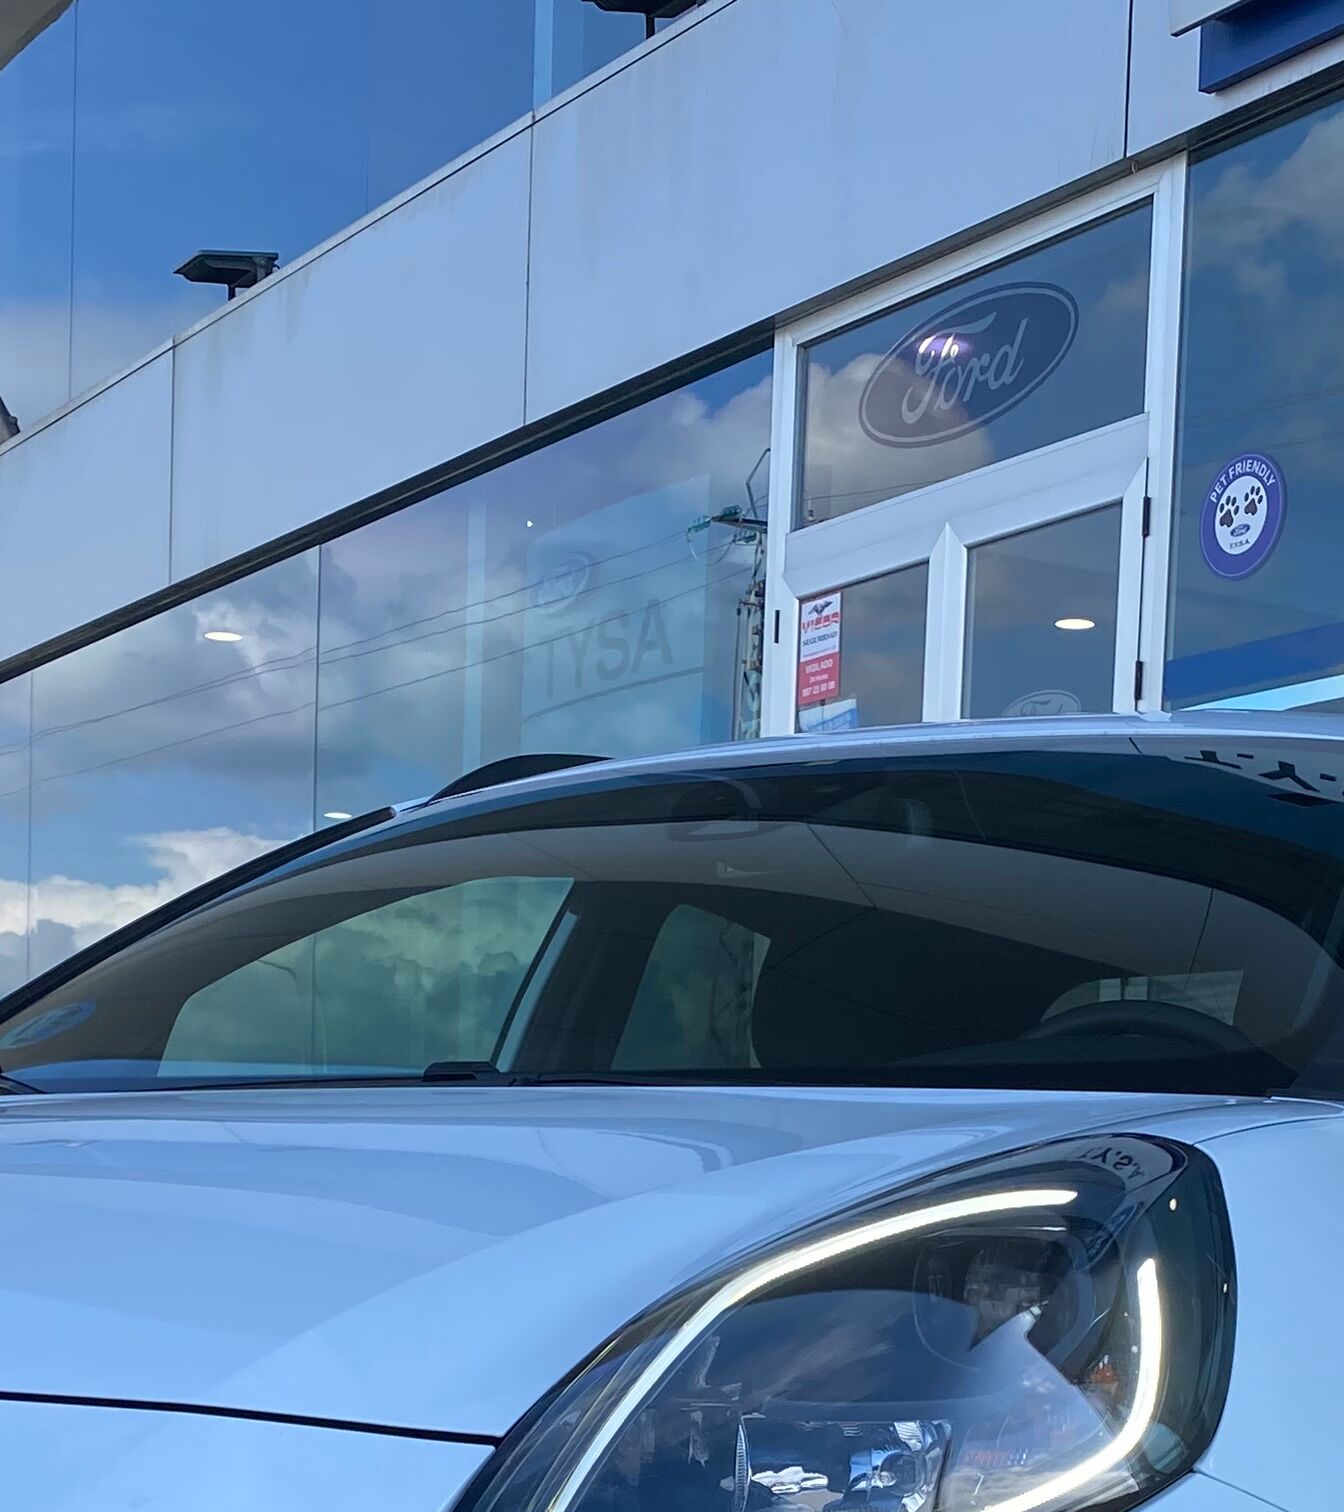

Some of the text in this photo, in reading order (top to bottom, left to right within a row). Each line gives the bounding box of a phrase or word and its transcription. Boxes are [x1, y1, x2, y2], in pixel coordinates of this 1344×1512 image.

[901, 311, 1030, 425] Ford
[1209, 459, 1276, 503] PET FRIENDLY
